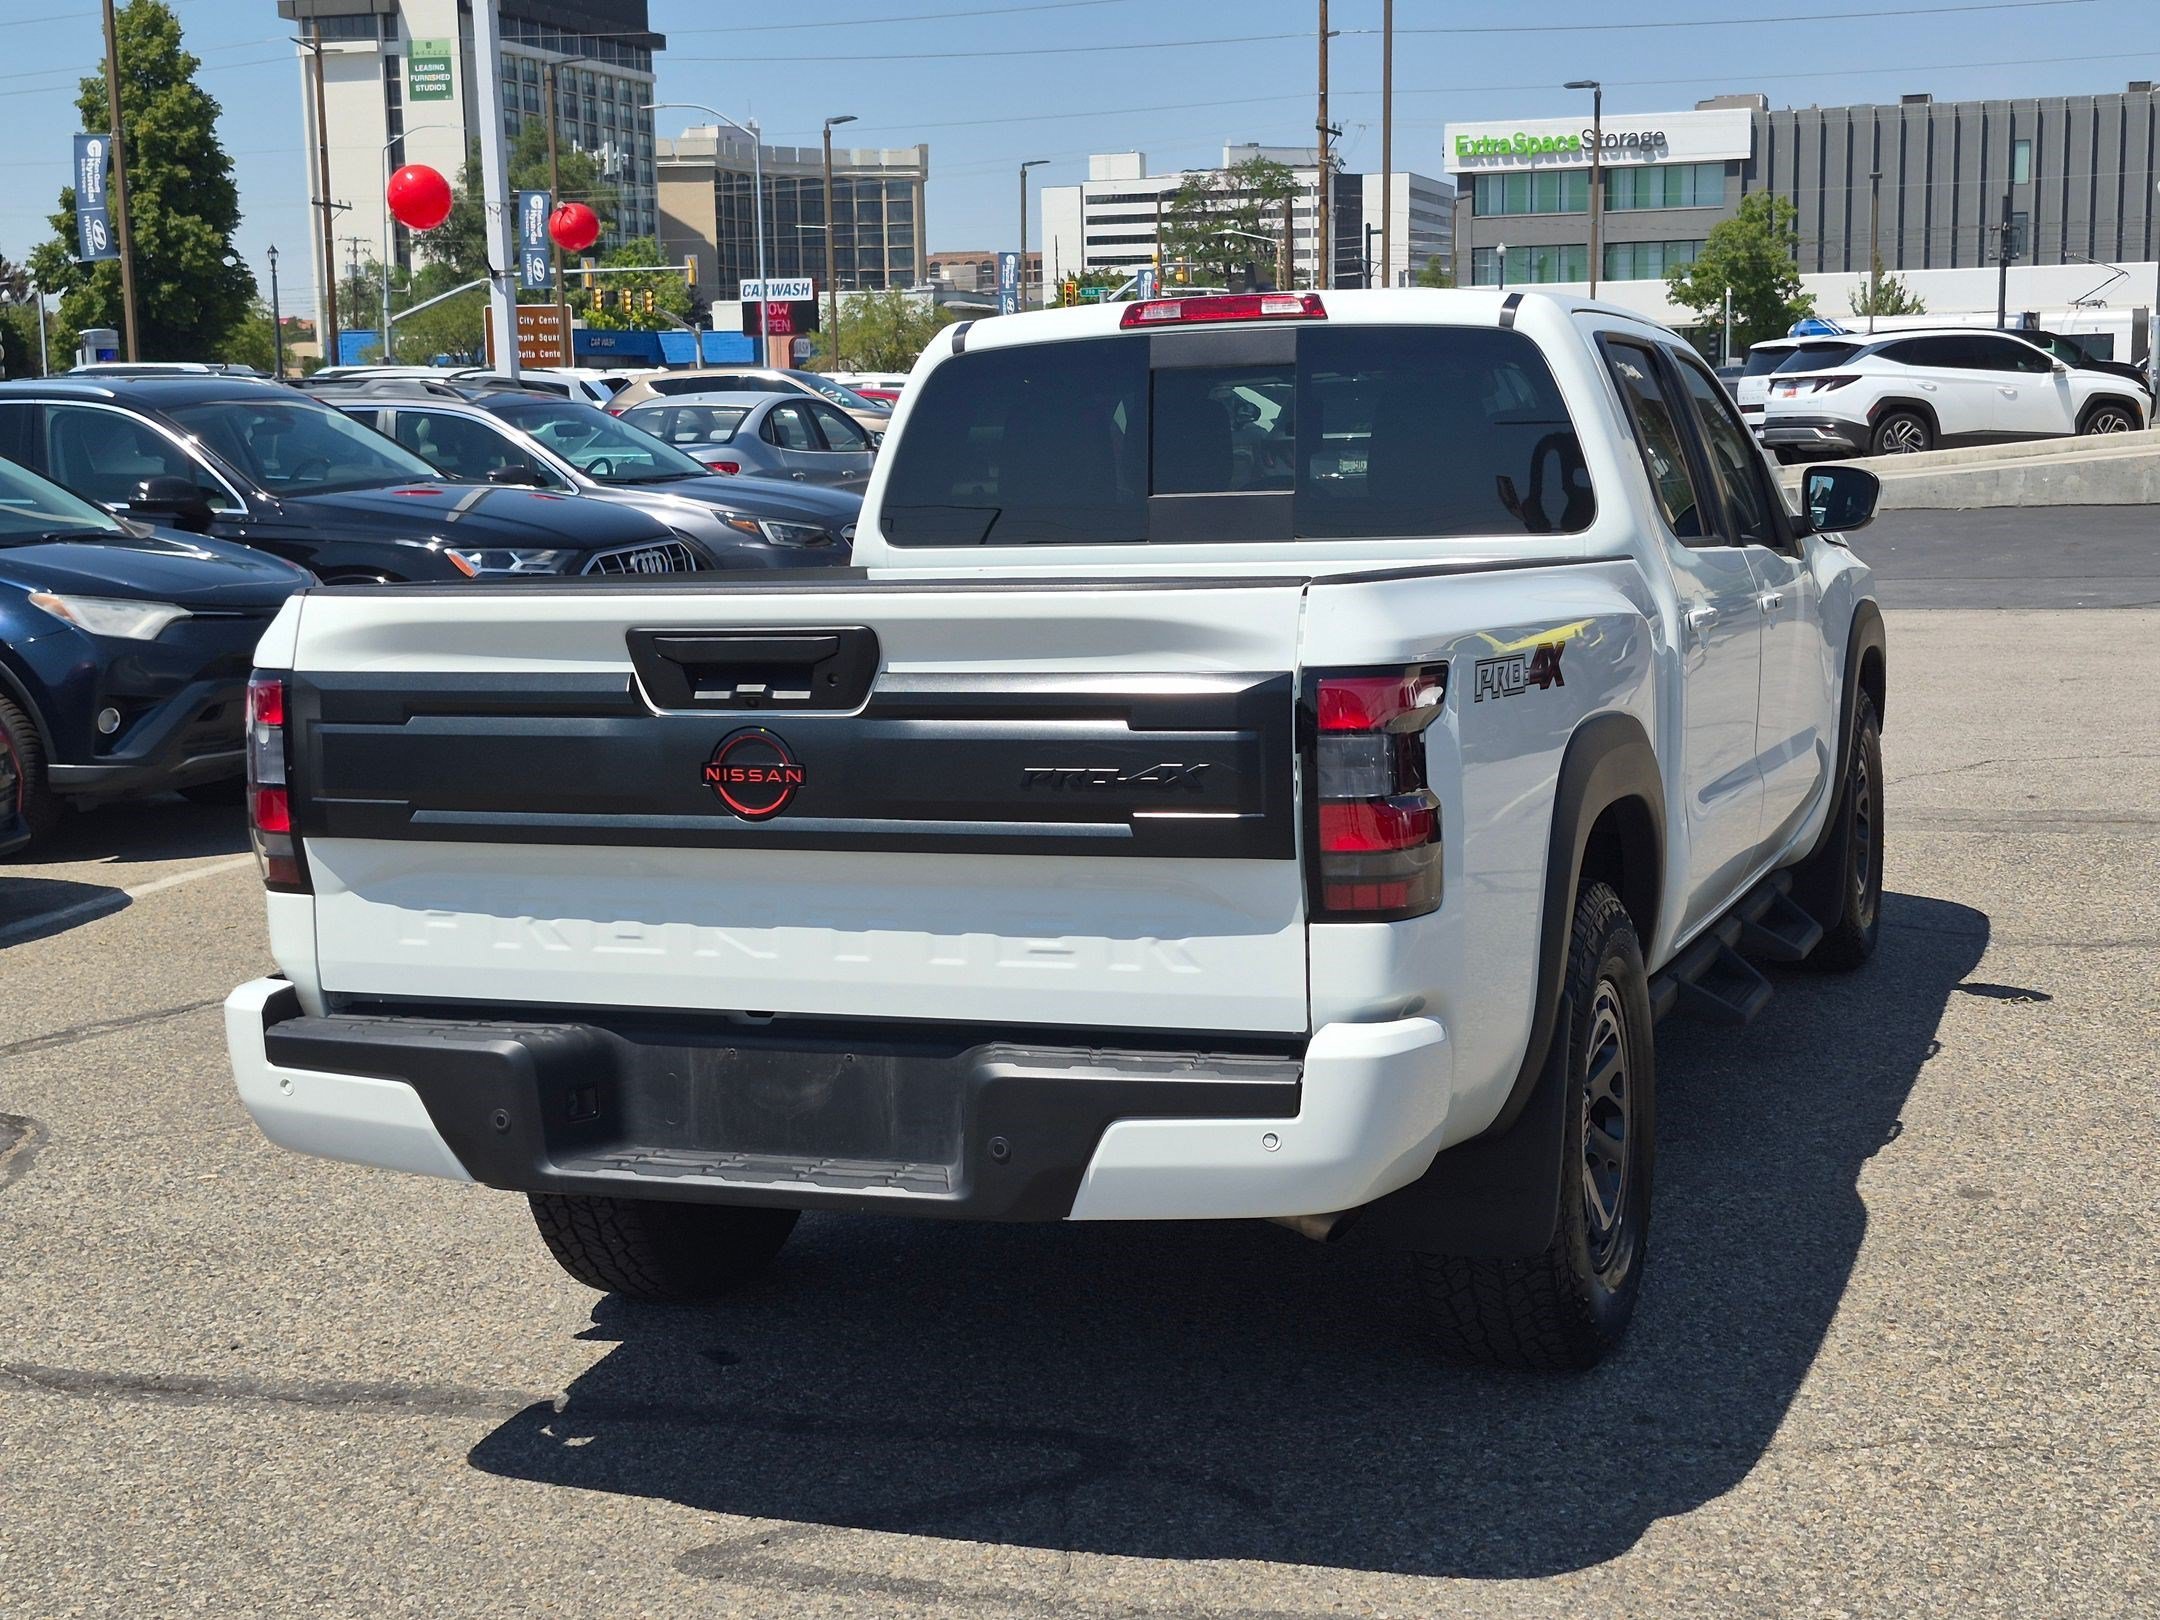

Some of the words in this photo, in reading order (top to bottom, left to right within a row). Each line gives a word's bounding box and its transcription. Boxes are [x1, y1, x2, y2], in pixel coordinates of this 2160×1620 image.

[415, 64, 445, 72] LEASING
[410, 74, 451, 82] FURNISHED
[415, 84, 447, 92] STUDIOS
[86, 158, 96, 203] Hyundai
[84, 215, 95, 256] HYUNDAI
[772, 283, 810, 296] WASH
[761, 303, 789, 316] OW
[519, 316, 535, 325] City
[539, 316, 560, 325] Cente
[760, 319, 791, 332] PEN
[517, 334, 534, 342] mple
[539, 333, 560, 343] Squar
[540, 350, 561, 358] Cente
[706, 767, 802, 783] NISSAN
